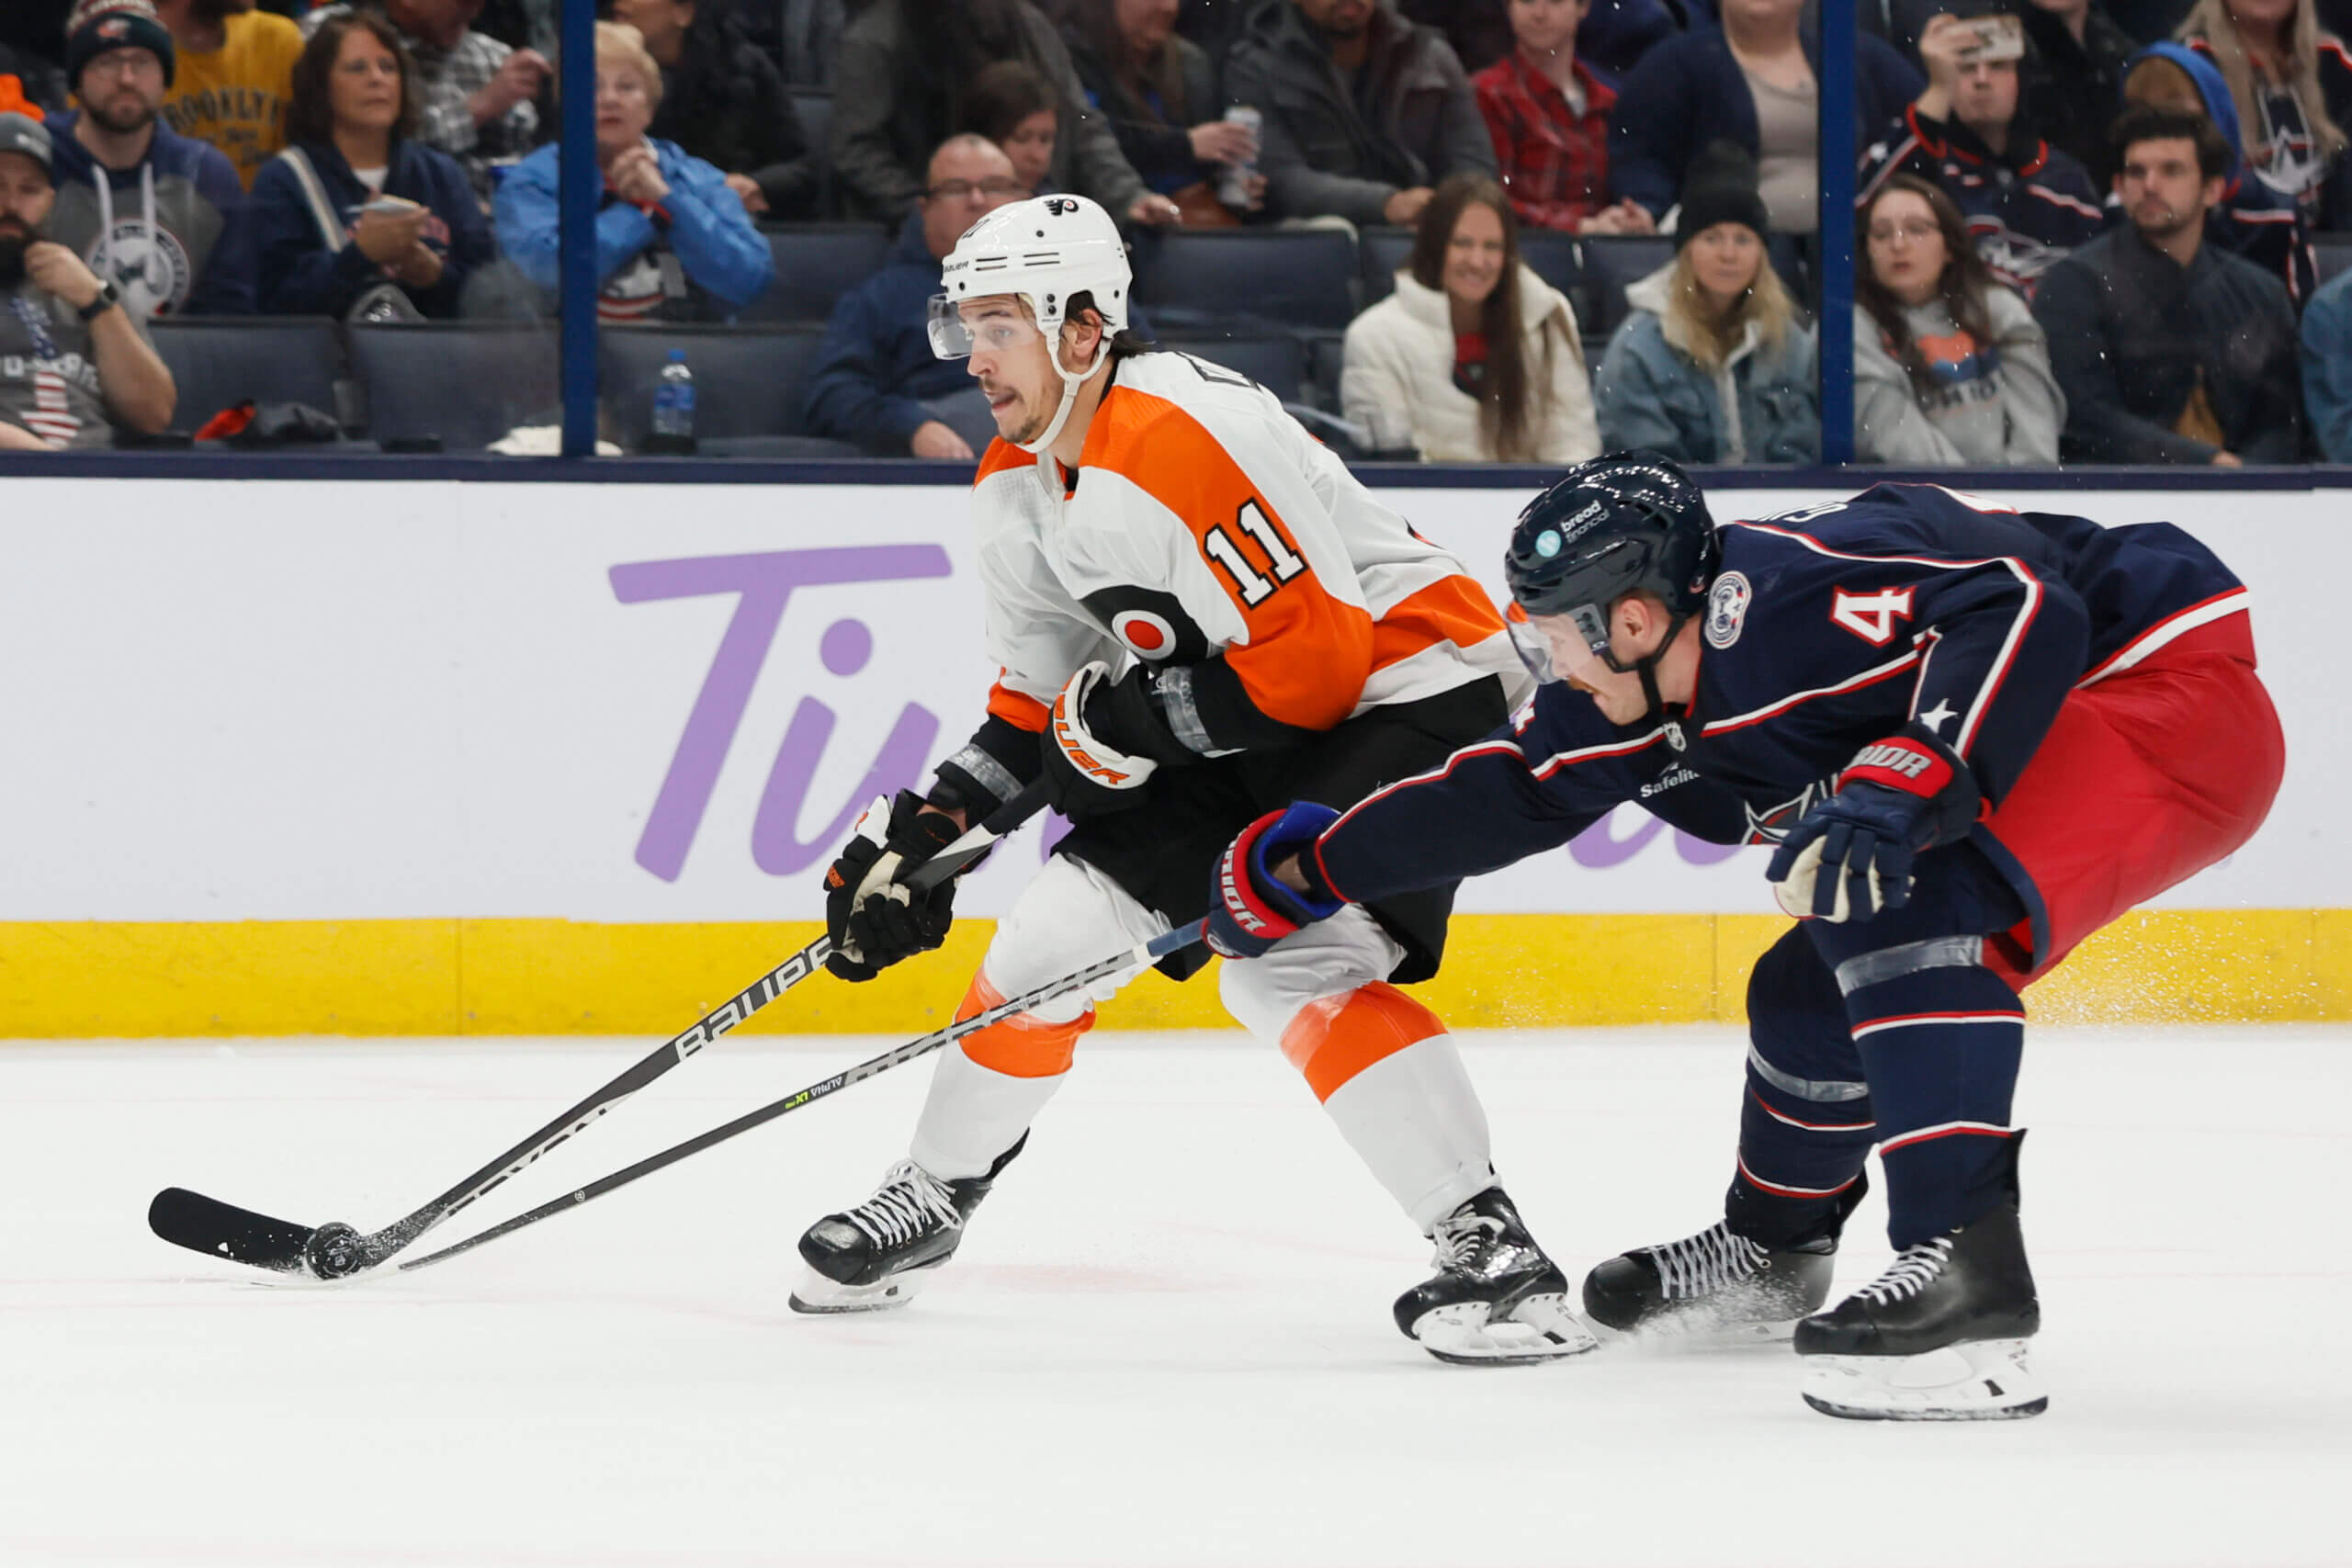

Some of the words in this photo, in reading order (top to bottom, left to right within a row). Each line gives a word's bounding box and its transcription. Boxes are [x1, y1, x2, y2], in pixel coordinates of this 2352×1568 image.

[1204, 496, 1309, 611] 11
[1560, 499, 1602, 533] bread
[1828, 585, 1918, 648] 4
[608, 544, 992, 883] Ti
[1054, 687, 1131, 785] AUER
[810, 1076, 842, 1098] ALPHA
